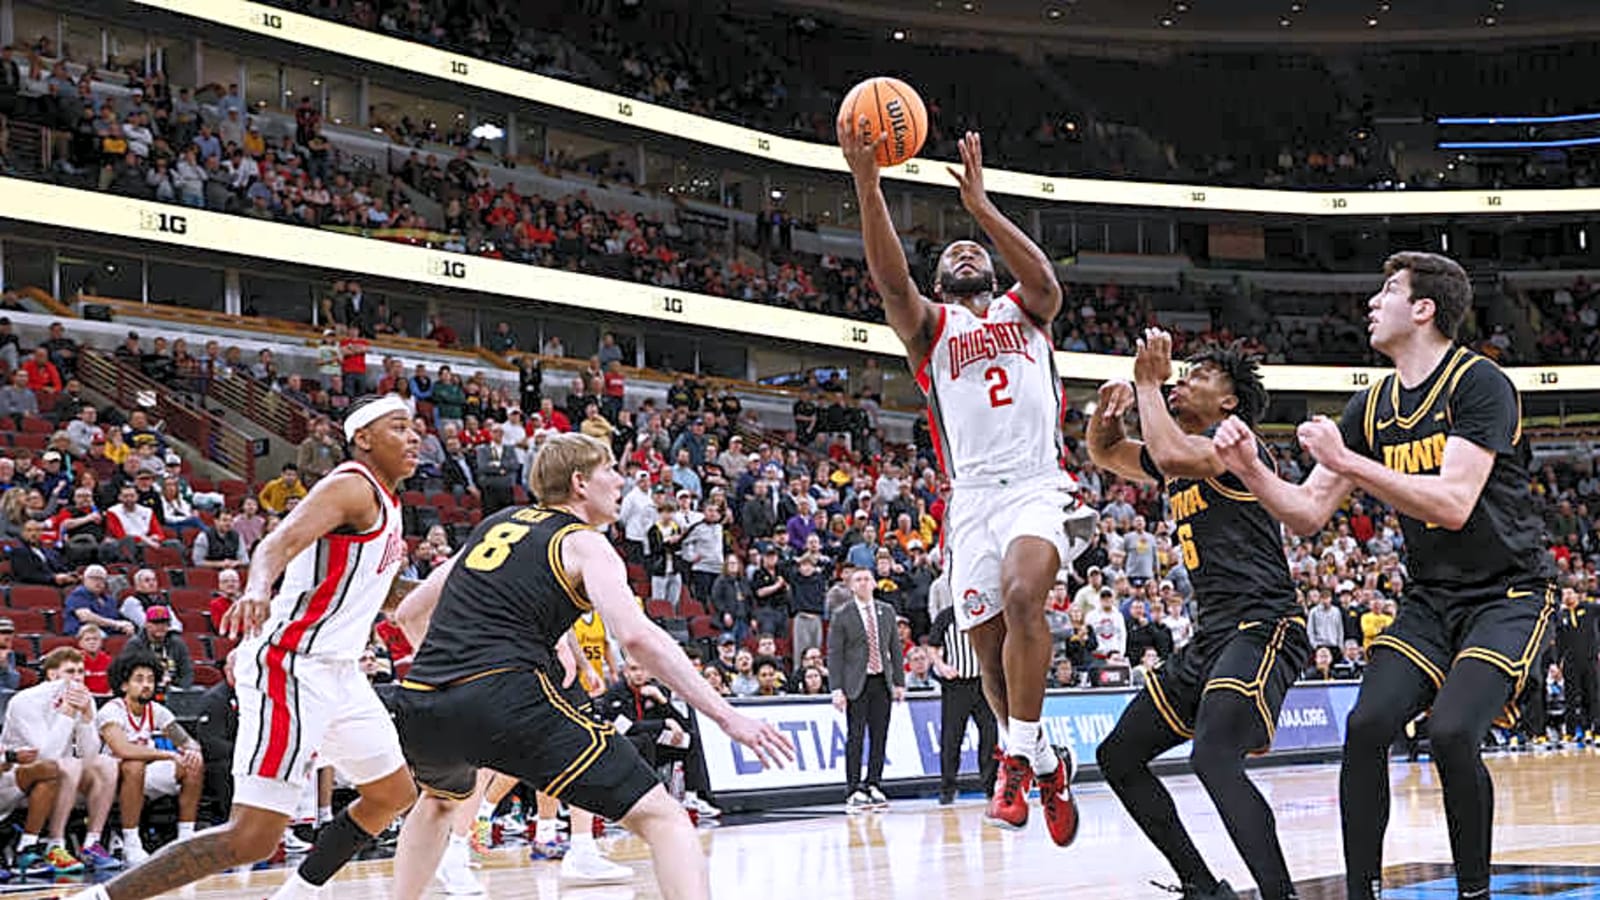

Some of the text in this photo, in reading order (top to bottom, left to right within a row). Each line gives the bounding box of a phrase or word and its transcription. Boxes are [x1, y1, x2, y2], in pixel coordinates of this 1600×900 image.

[984, 366, 1013, 408] 2
[464, 522, 531, 572] 8
[1177, 523, 1200, 570] 6
[583, 645, 601, 660] 55
